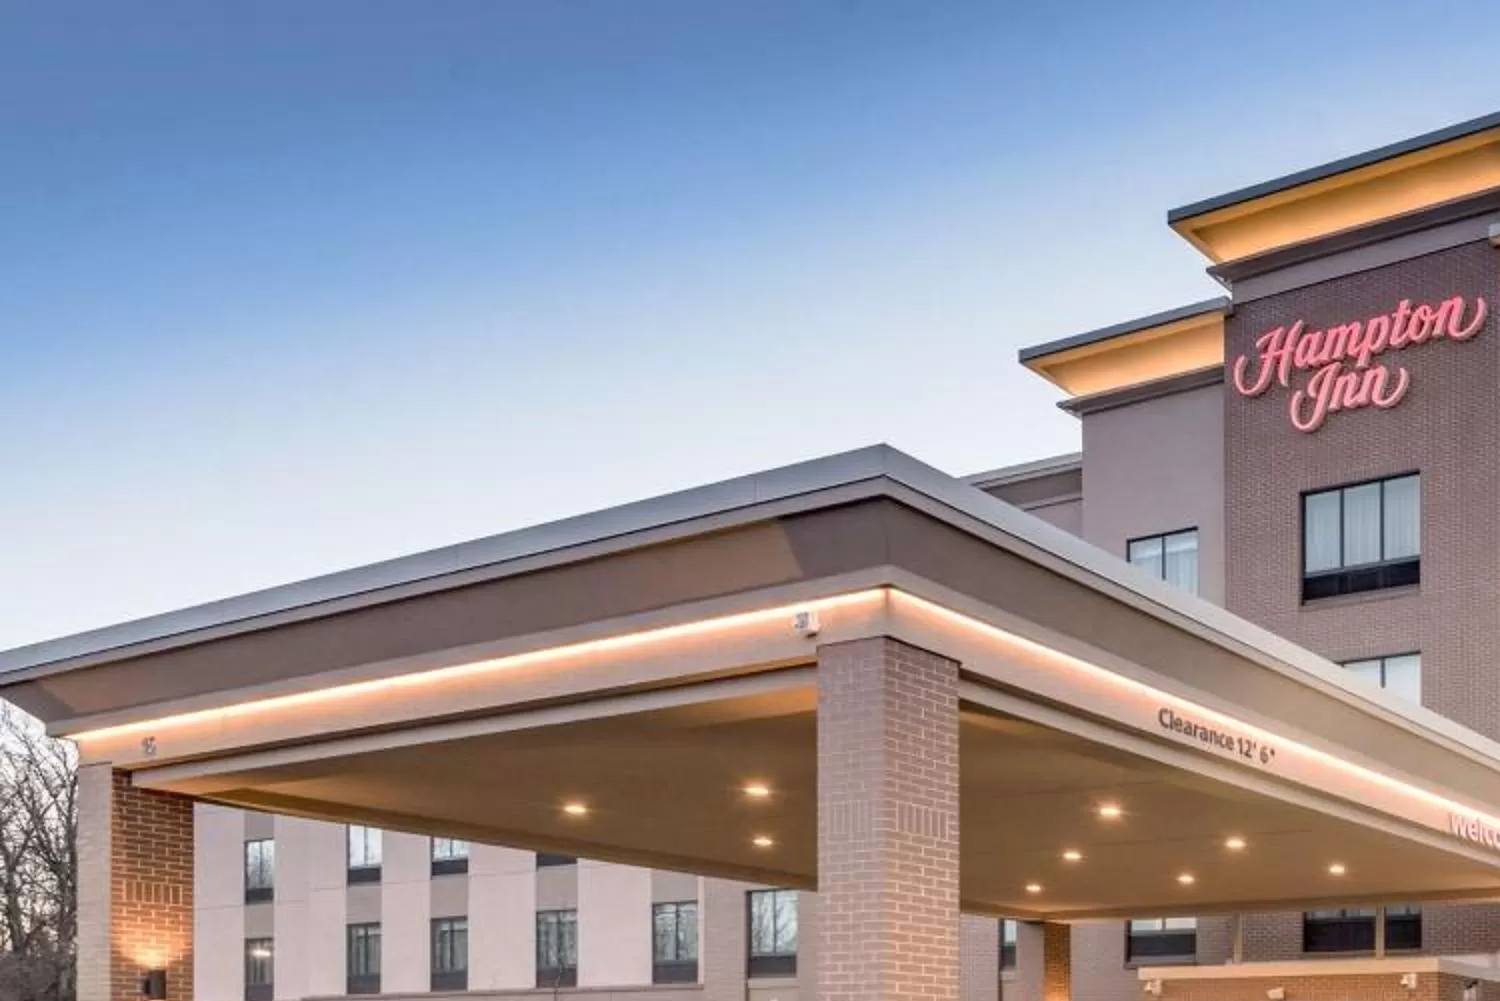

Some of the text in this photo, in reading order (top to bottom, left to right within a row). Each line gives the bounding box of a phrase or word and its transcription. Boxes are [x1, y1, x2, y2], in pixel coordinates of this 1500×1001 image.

[1233, 295, 1487, 396] Hampton
[1290, 361, 1410, 432] Inn
[1158, 707, 1235, 751] Clearance
